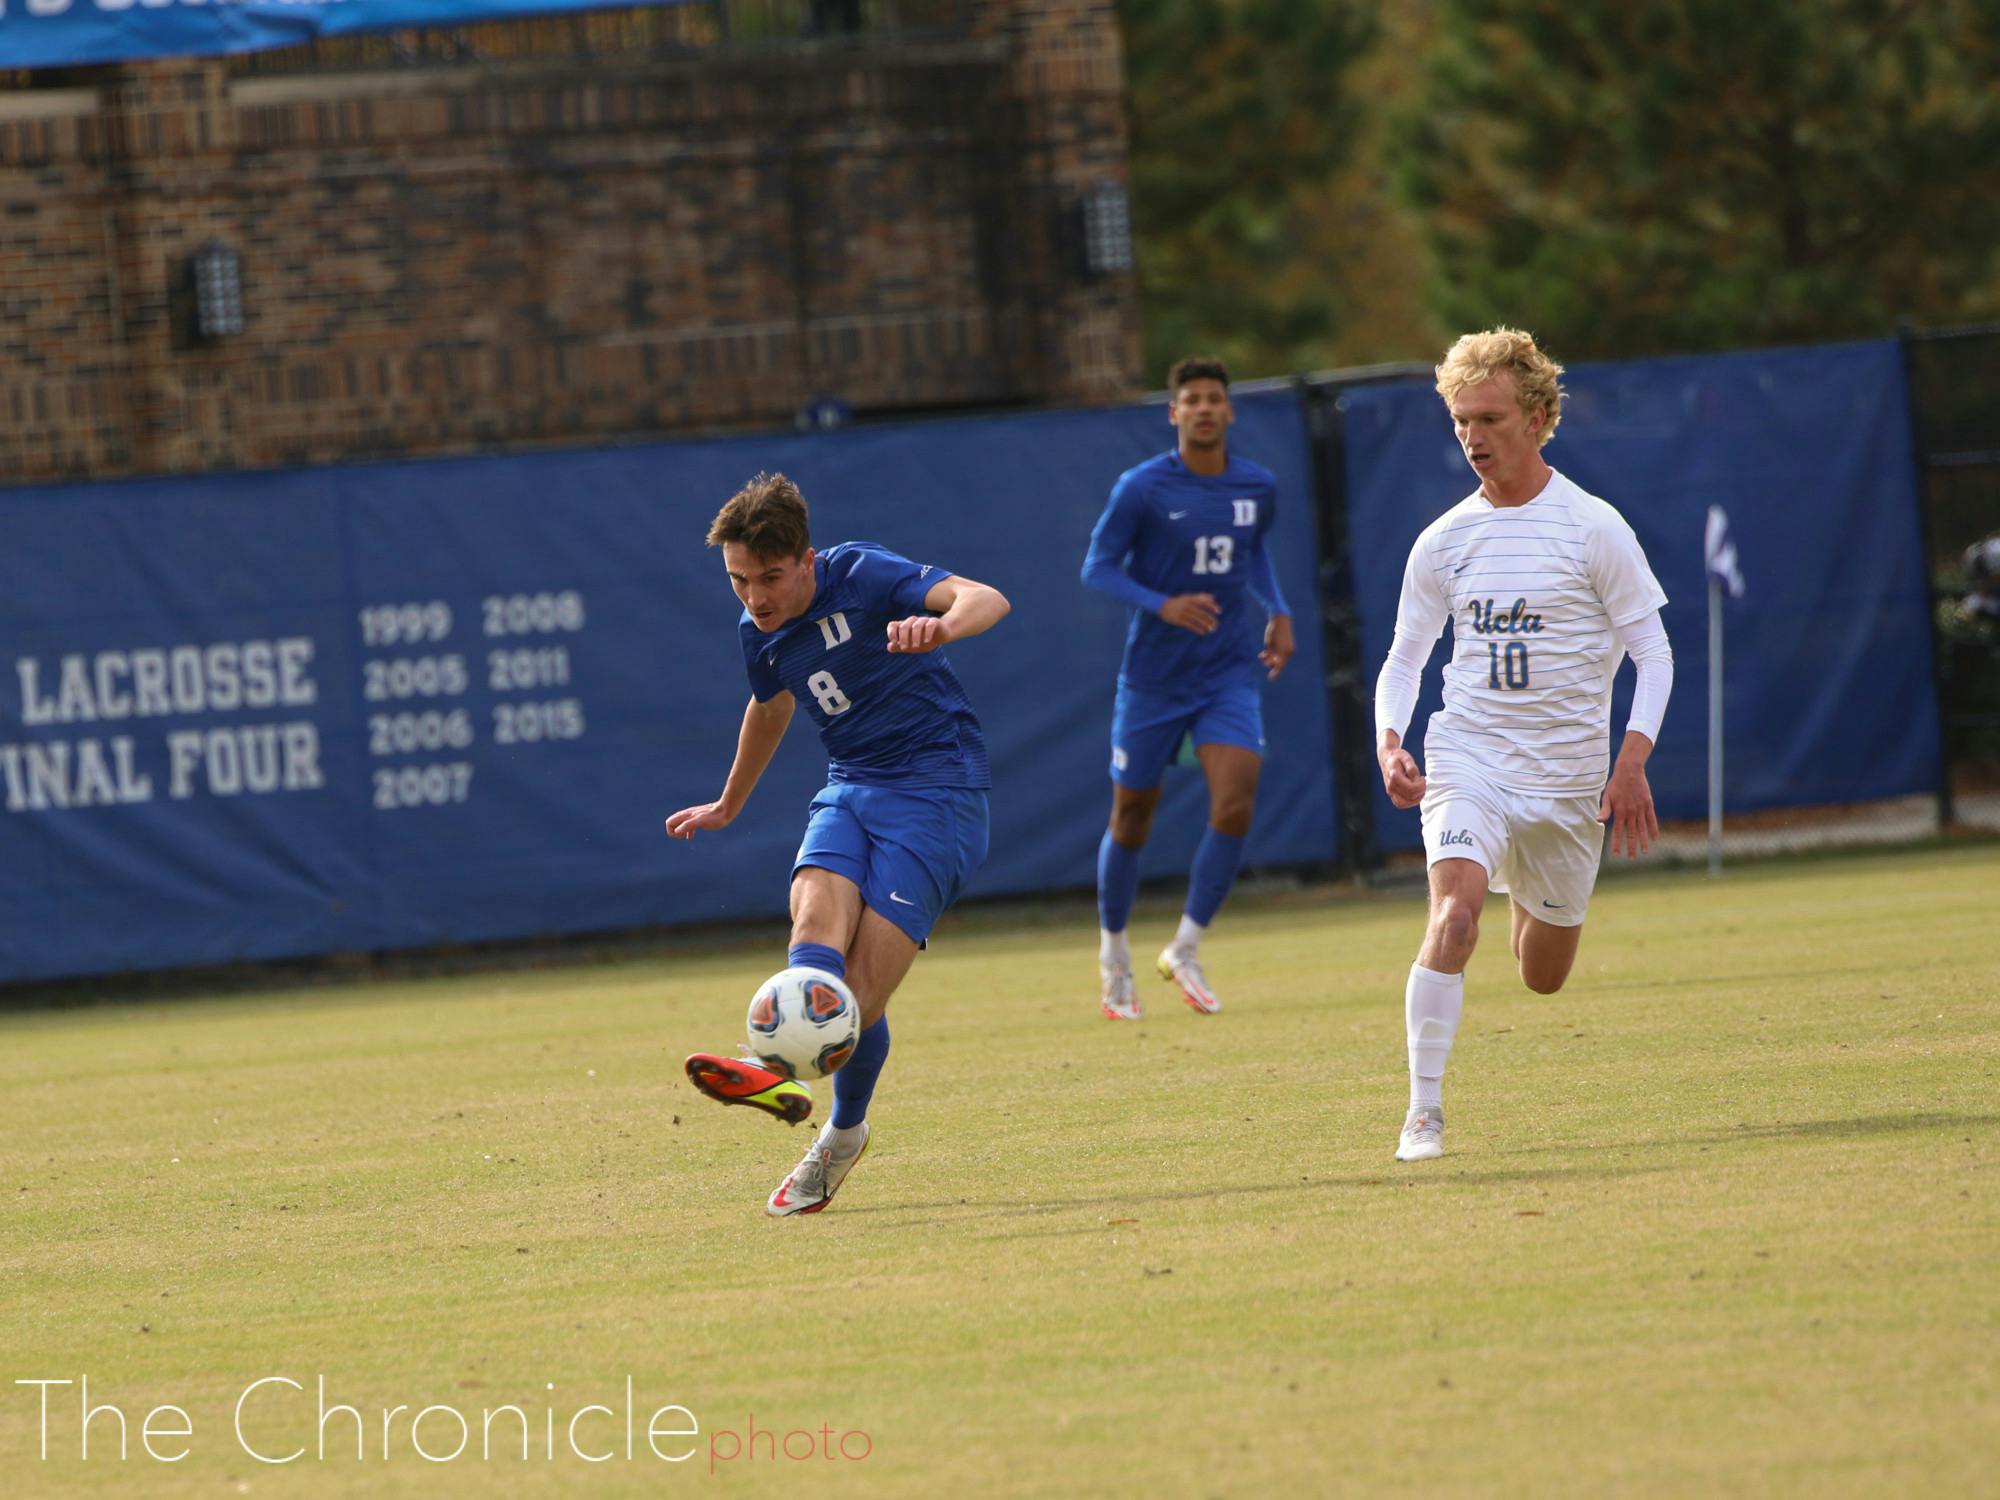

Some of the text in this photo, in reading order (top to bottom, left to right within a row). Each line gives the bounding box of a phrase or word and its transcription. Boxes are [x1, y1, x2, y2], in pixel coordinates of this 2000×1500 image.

[1231, 499, 1257, 527] D
[1192, 535, 1234, 575] 13
[358, 600, 452, 646] 1999
[16, 637, 318, 726] LACROSSE
[363, 646, 570, 700] 2005 2011
[1487, 641, 1529, 690] 10
[807, 670, 852, 716] 8
[369, 697, 585, 755] 2006 2015
[0, 720, 325, 812] INAL FOUR
[373, 762, 474, 810] 2007
